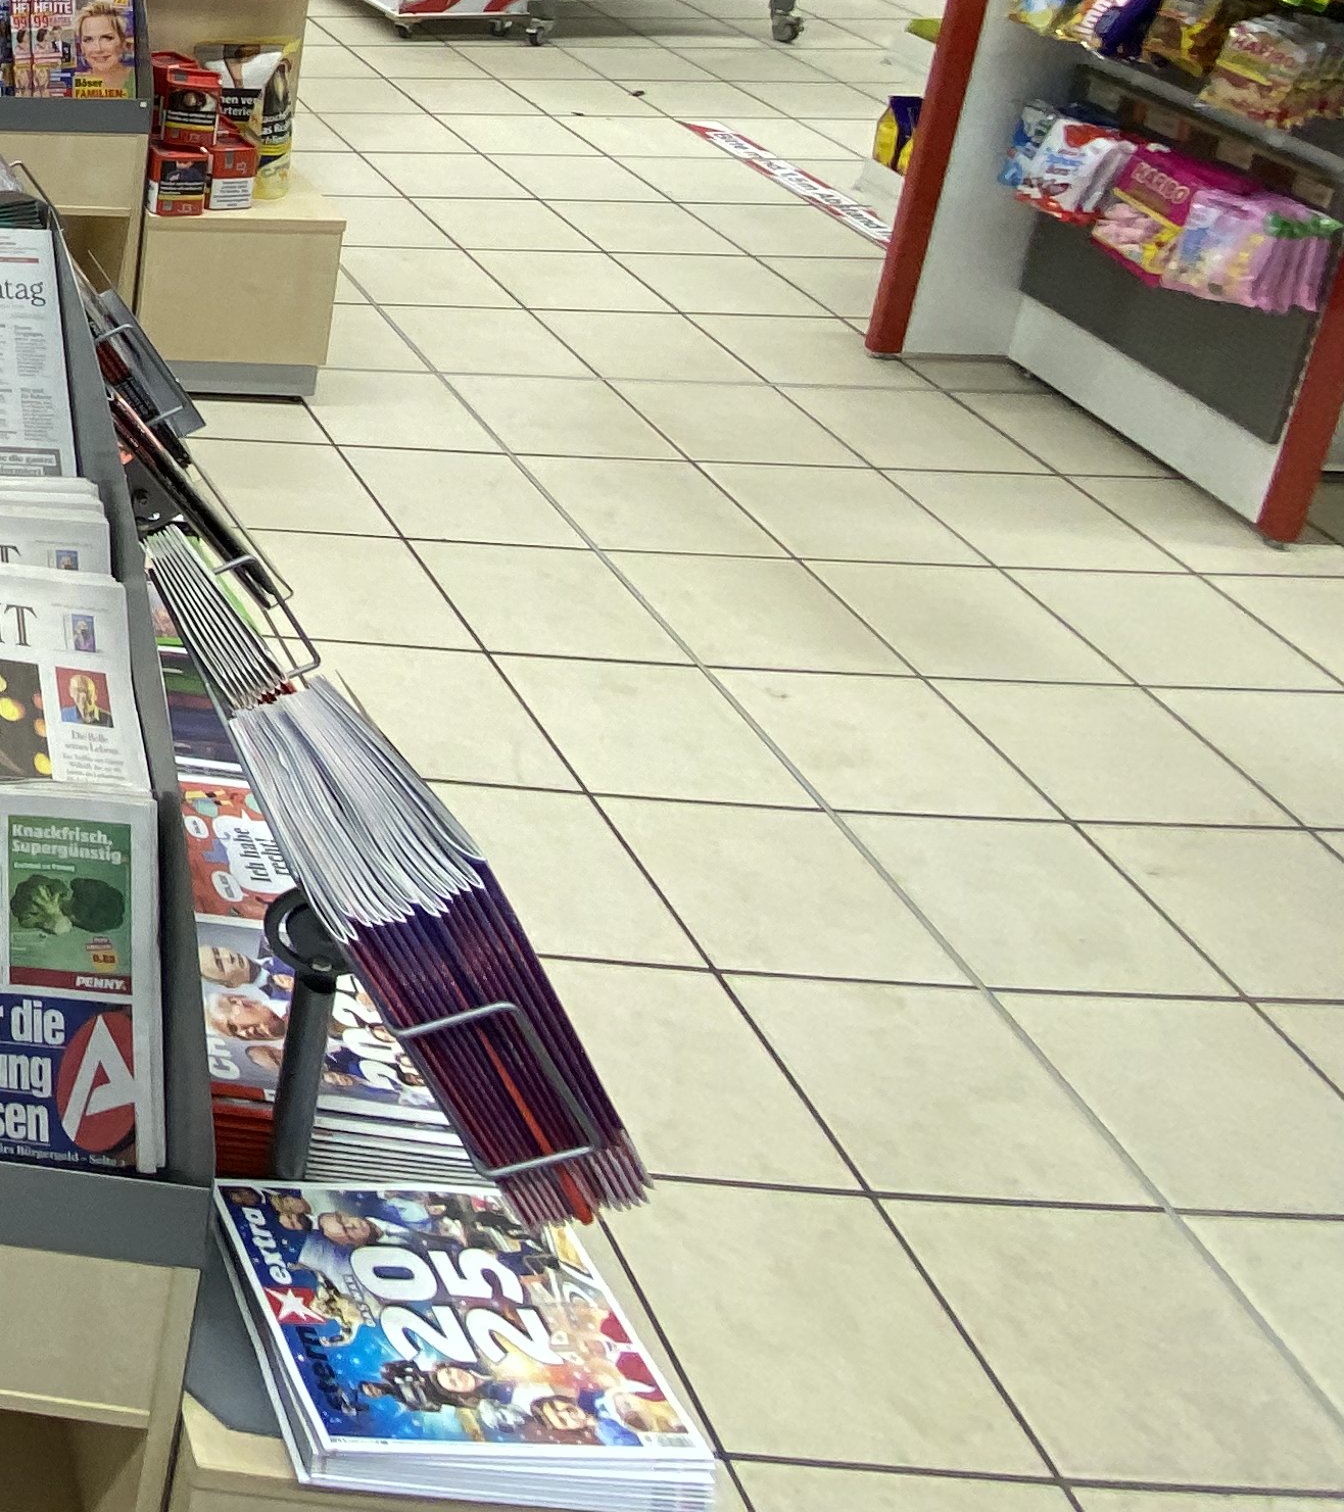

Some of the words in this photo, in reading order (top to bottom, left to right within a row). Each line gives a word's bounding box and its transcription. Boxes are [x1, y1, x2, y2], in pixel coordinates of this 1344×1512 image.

[34, 1, 72, 16] HEUTE
[75, 77, 103, 88] Böser
[12, 823, 113, 845] Knackfrisch,
[233, 827, 261, 859] habe
[244, 862, 272, 883] Ich
[10, 1003, 66, 1046] die
